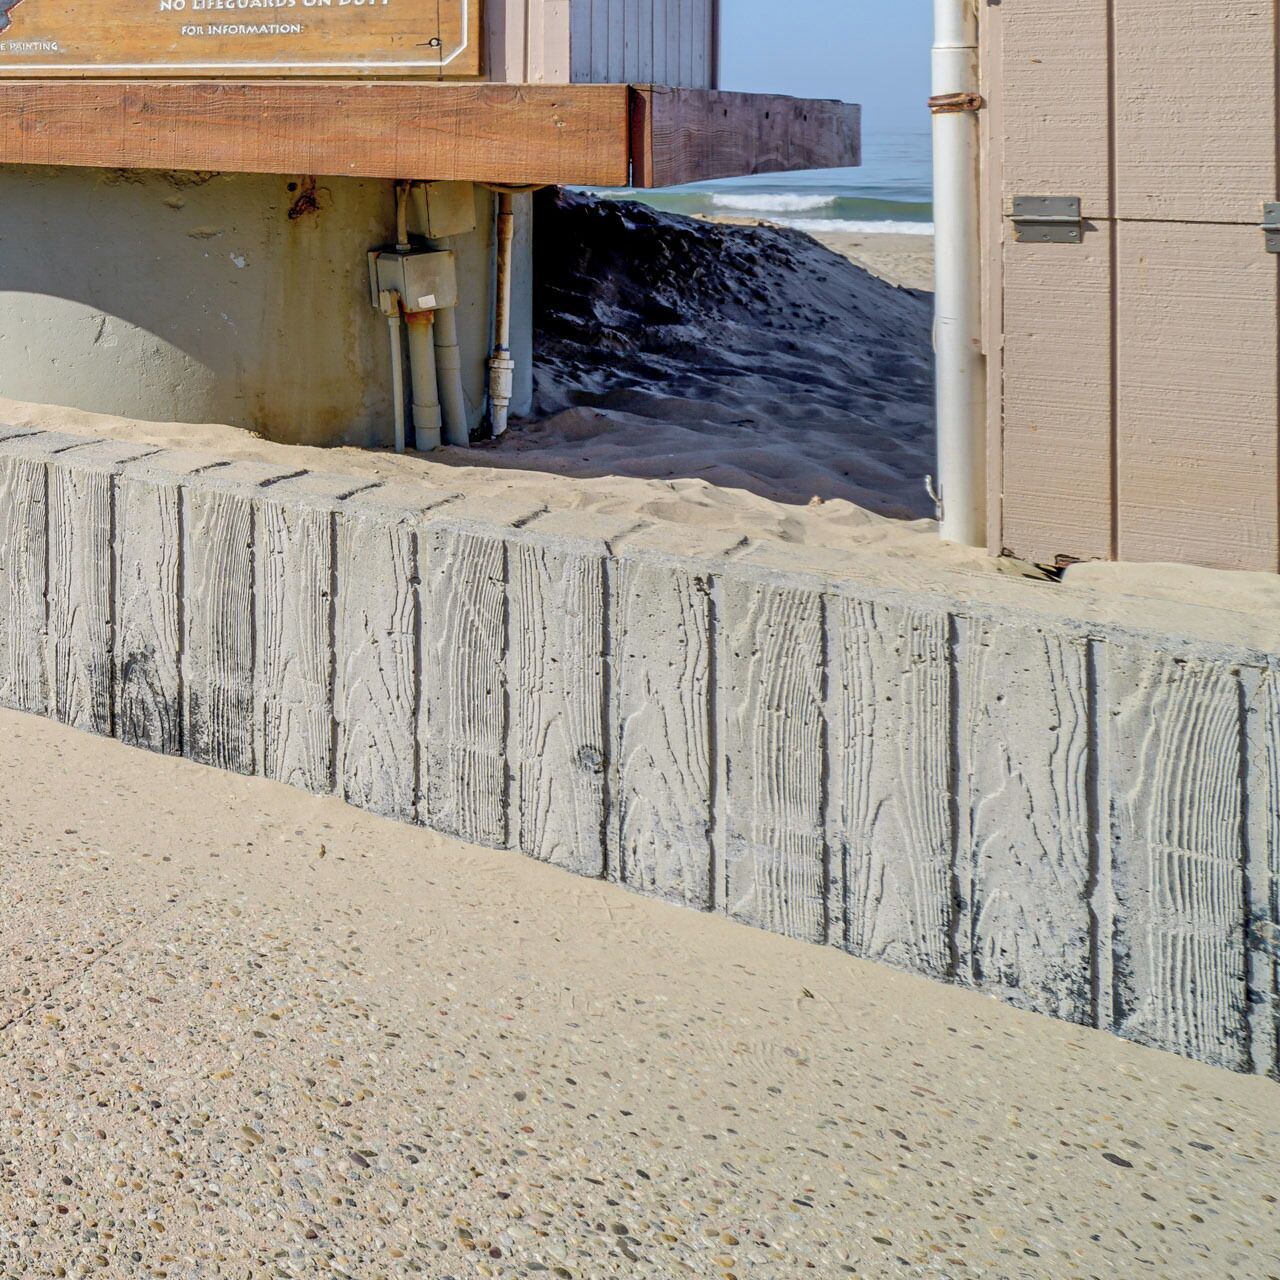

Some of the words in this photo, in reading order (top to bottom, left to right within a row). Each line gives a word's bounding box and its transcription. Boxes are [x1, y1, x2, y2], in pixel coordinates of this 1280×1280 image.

[181, 24, 204, 36] FOR
[207, 23, 305, 35] INFORMATION:
[9, 41, 58, 52] PAINTING
